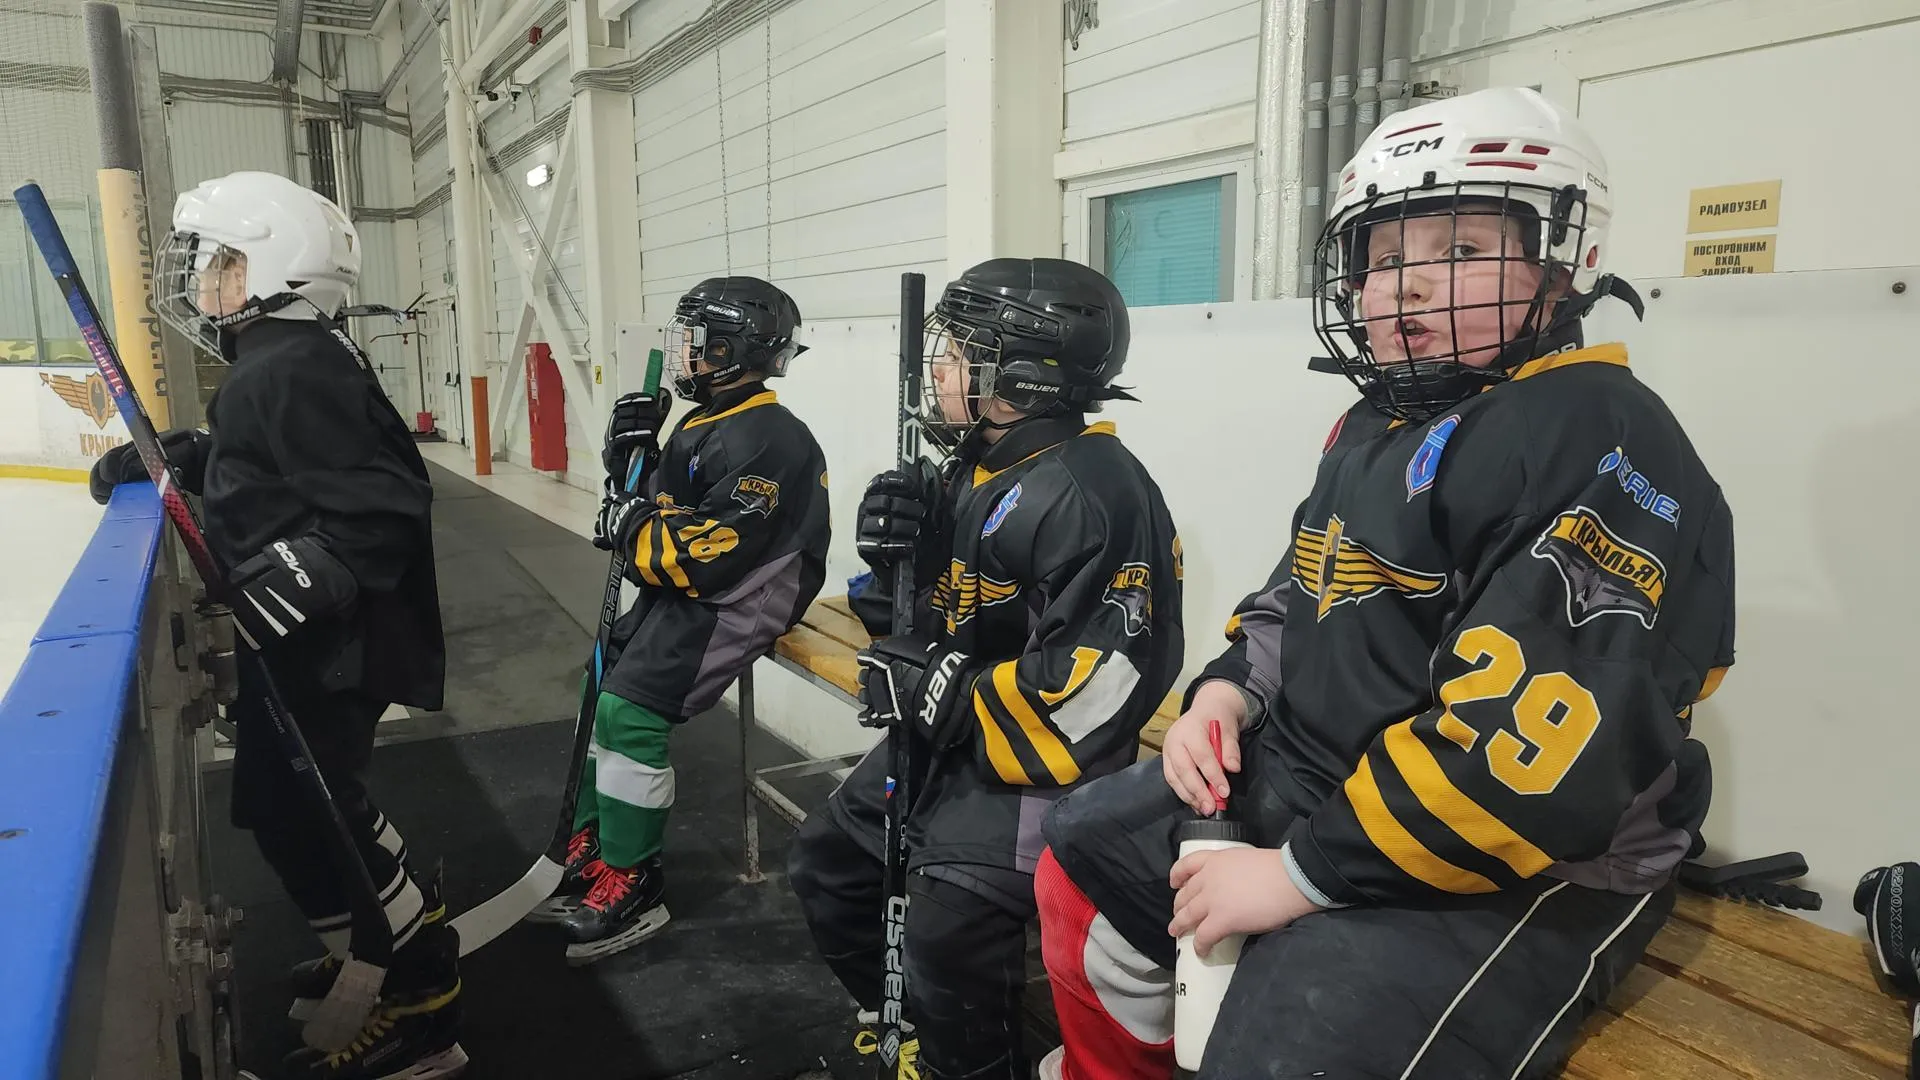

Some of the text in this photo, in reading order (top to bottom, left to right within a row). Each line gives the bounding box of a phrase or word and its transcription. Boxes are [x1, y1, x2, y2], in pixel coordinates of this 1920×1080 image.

[1587, 171, 1608, 193] CCM
[1699, 199, 1767, 216] РАДИОУЗЕЛ
[1693, 241, 1767, 256] ПОСТОРОННИМ
[1715, 255, 1741, 266] ВХОД
[330, 328, 367, 371] PRIME
[713, 363, 740, 378] BAUER
[1015, 381, 1060, 394] BAUER
[677, 519, 739, 563] 18
[1576, 518, 1657, 584] КРЫЛЬЯ
[1436, 624, 1602, 795] 29
